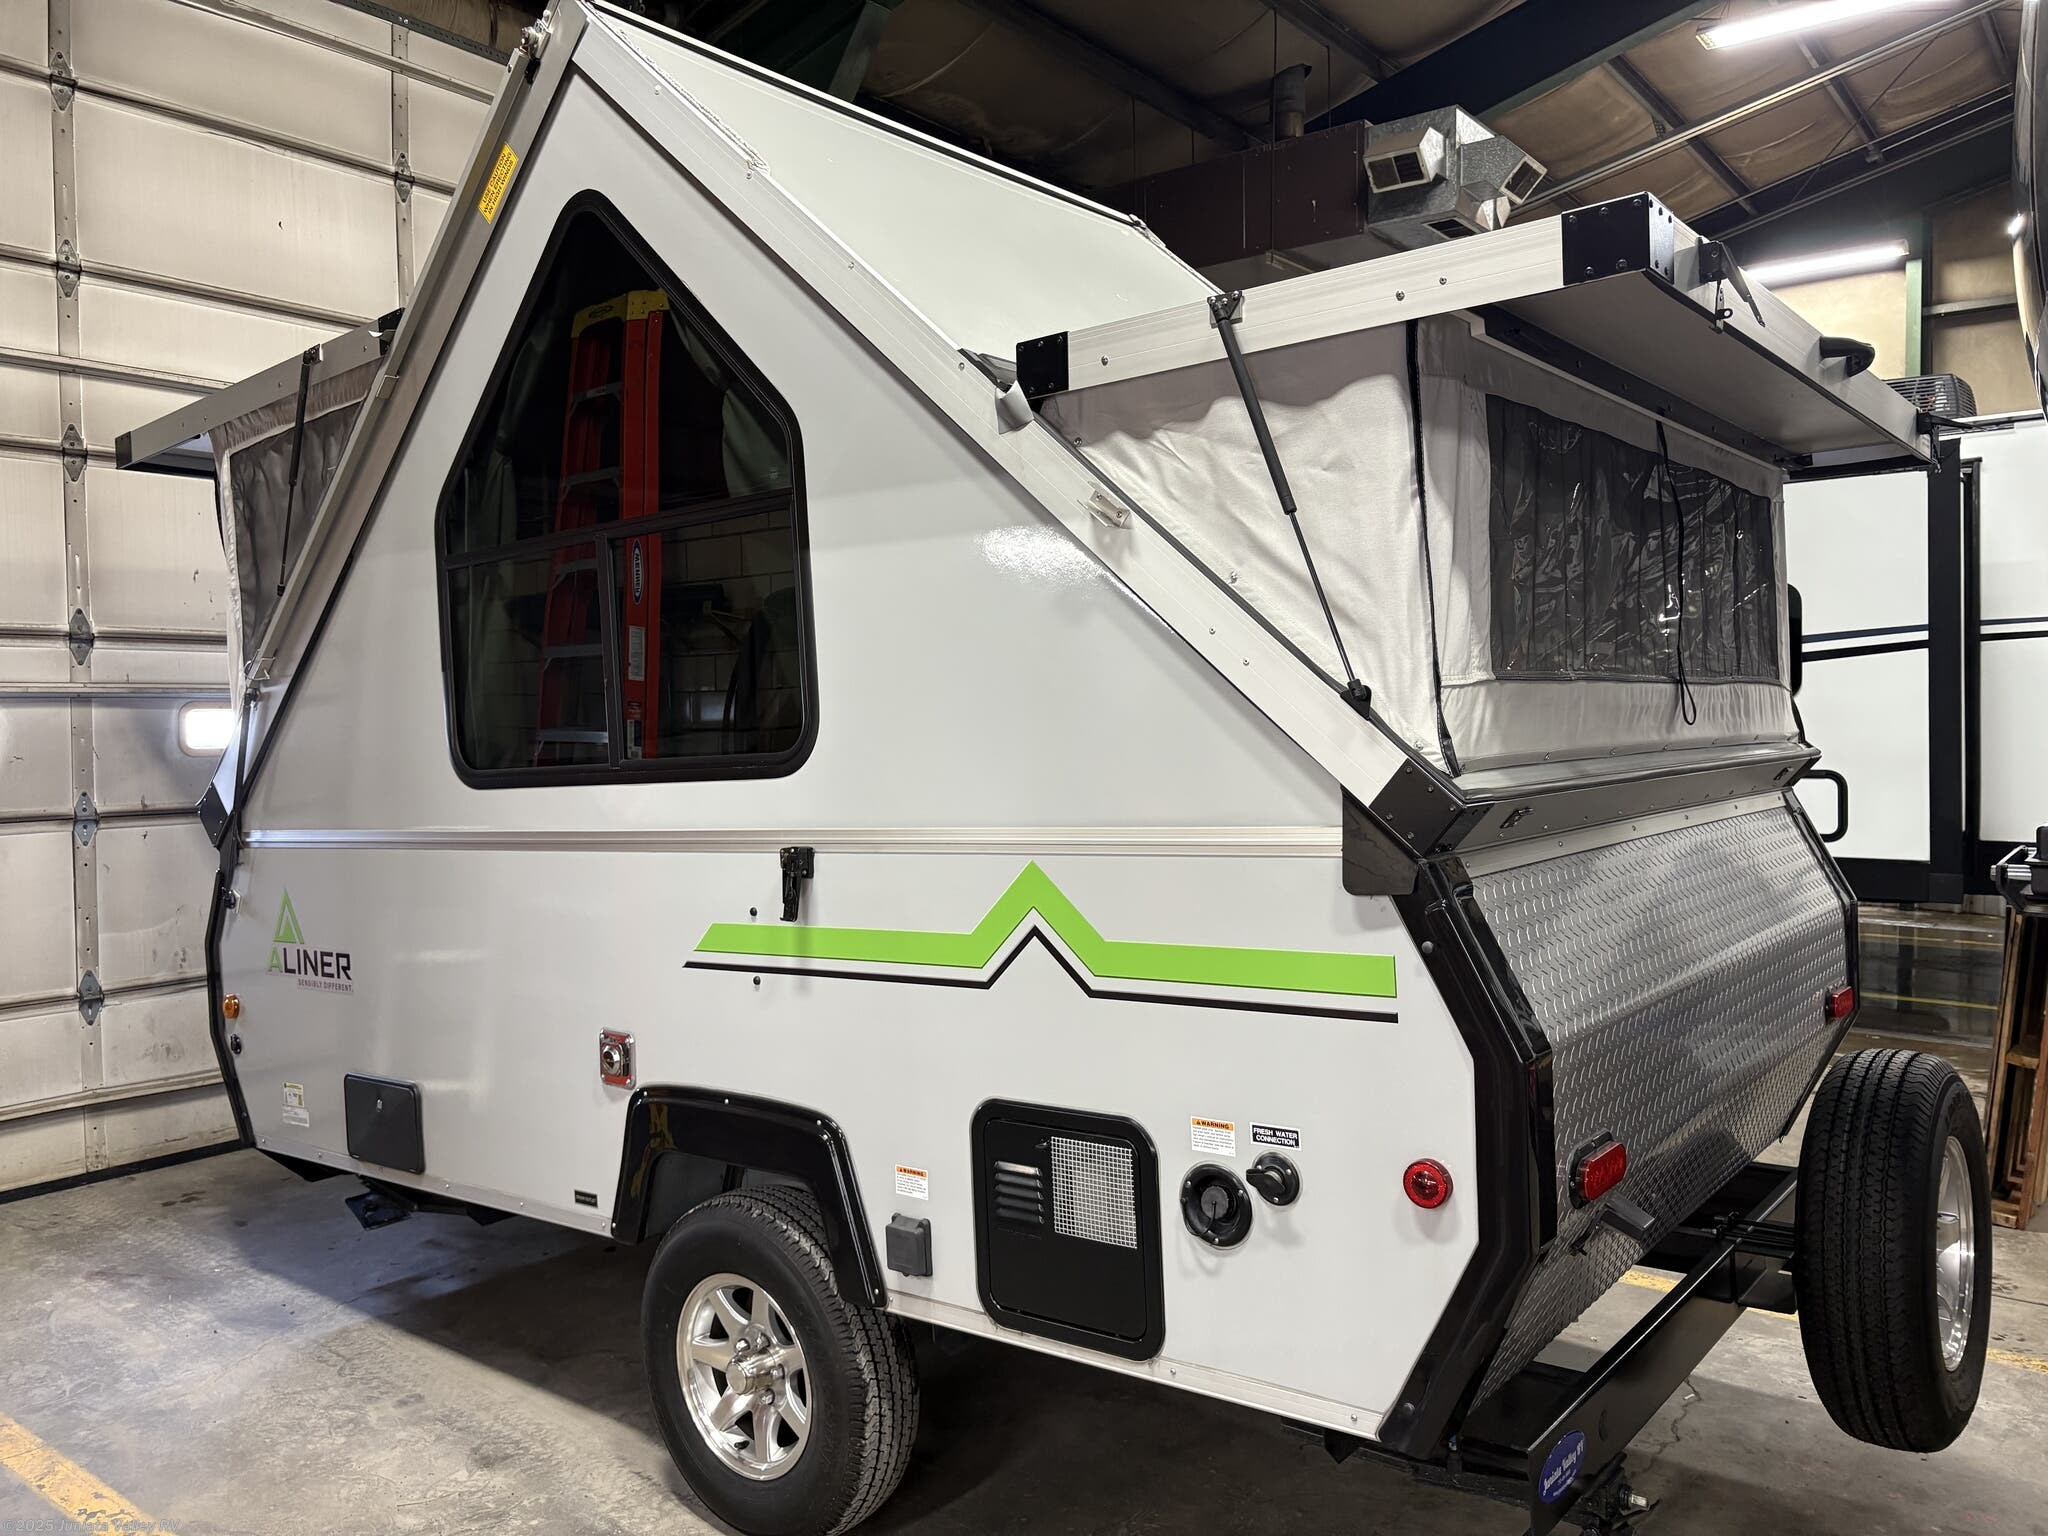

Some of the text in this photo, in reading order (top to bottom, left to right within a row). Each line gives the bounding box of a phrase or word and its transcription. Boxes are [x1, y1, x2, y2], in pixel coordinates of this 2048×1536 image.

[482, 152, 506, 203] USE CAUTION
[484, 152, 511, 213] WHEN ERECTING
[488, 160, 513, 215] IN HIGH WINDS
[267, 946, 352, 981] ALINER
[298, 979, 322, 989] SENSIBLY
[1201, 1120, 1230, 1130] WARNING
[1253, 1127, 1298, 1139] FRESH WATER
[1256, 1134, 1296, 1146] CONNECTION
